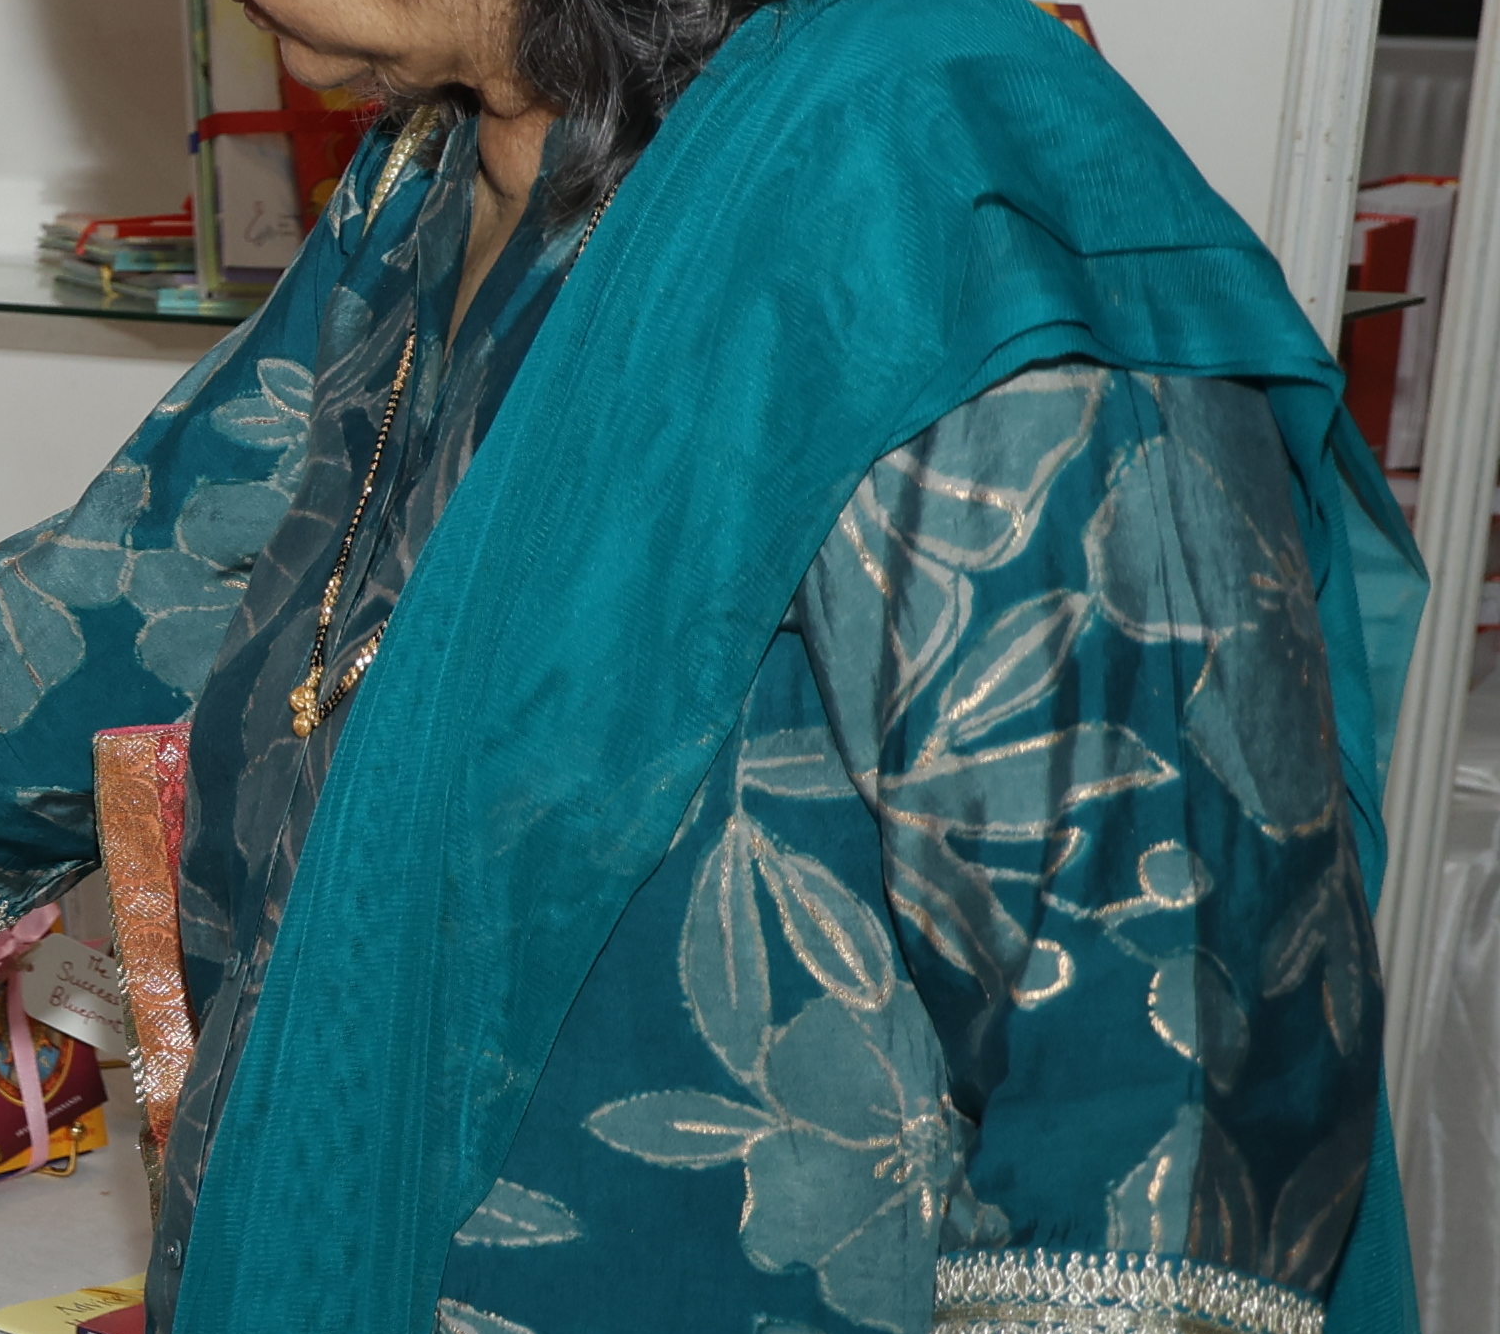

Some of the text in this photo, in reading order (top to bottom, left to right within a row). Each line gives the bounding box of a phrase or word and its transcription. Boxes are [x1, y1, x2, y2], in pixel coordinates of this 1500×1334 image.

[54, 962, 122, 1010] Success
[86, 953, 111, 979] The
[48, 988, 126, 1035] Blueprint
